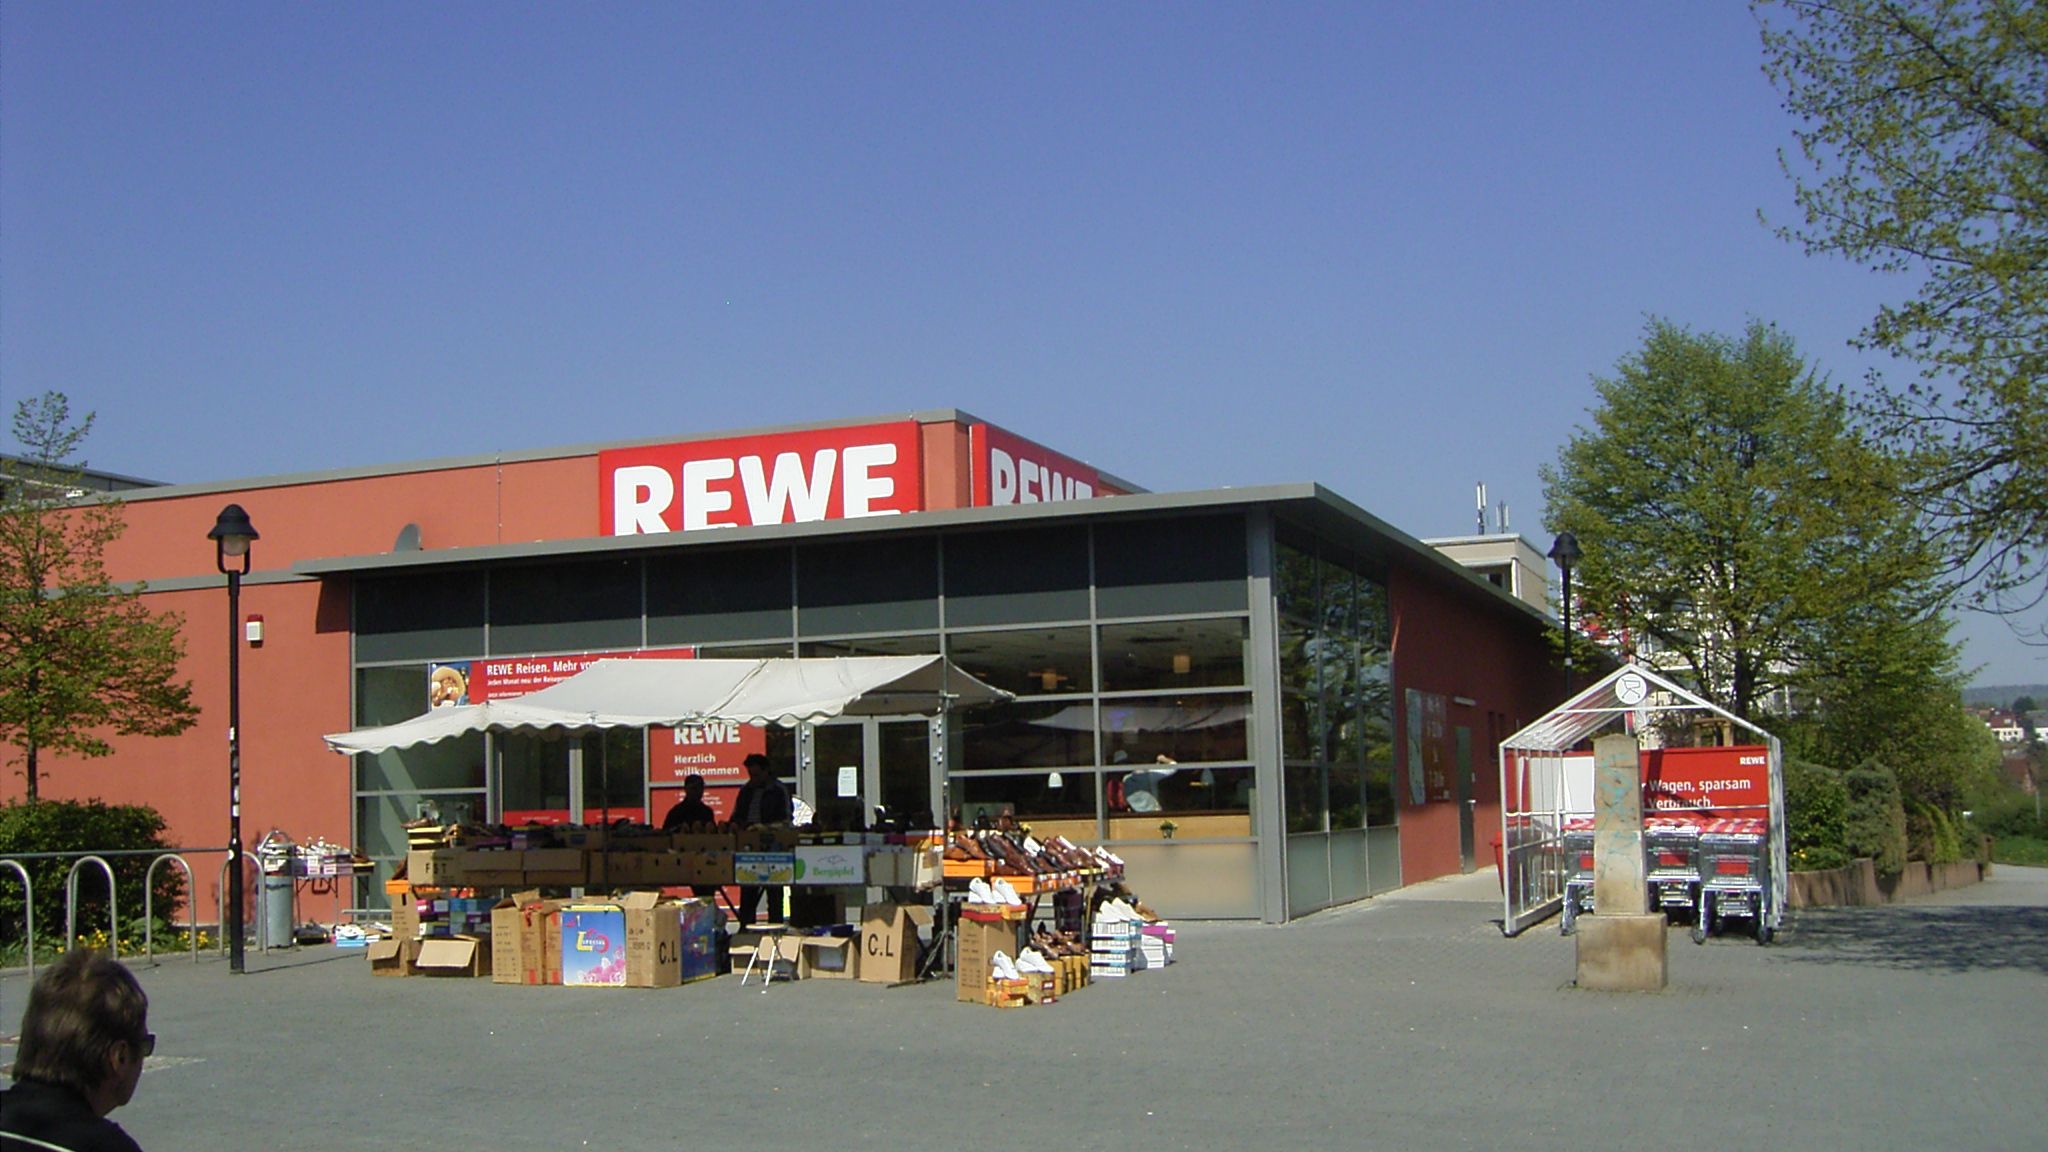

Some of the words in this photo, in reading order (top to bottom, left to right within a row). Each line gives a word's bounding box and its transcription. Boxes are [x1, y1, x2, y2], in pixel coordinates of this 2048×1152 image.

[614, 443, 899, 536] REWE
[487, 664, 513, 676] REWE
[516, 662, 550, 675] Reisen.
[553, 660, 578, 673] Mehr
[674, 723, 741, 745] REWE
[674, 753, 716, 765] Herzlich
[1739, 756, 1766, 766] REWE
[675, 767, 740, 777] willkommen
[1649, 779, 1696, 795] Wagen,
[1698, 778, 1751, 793] sparsam
